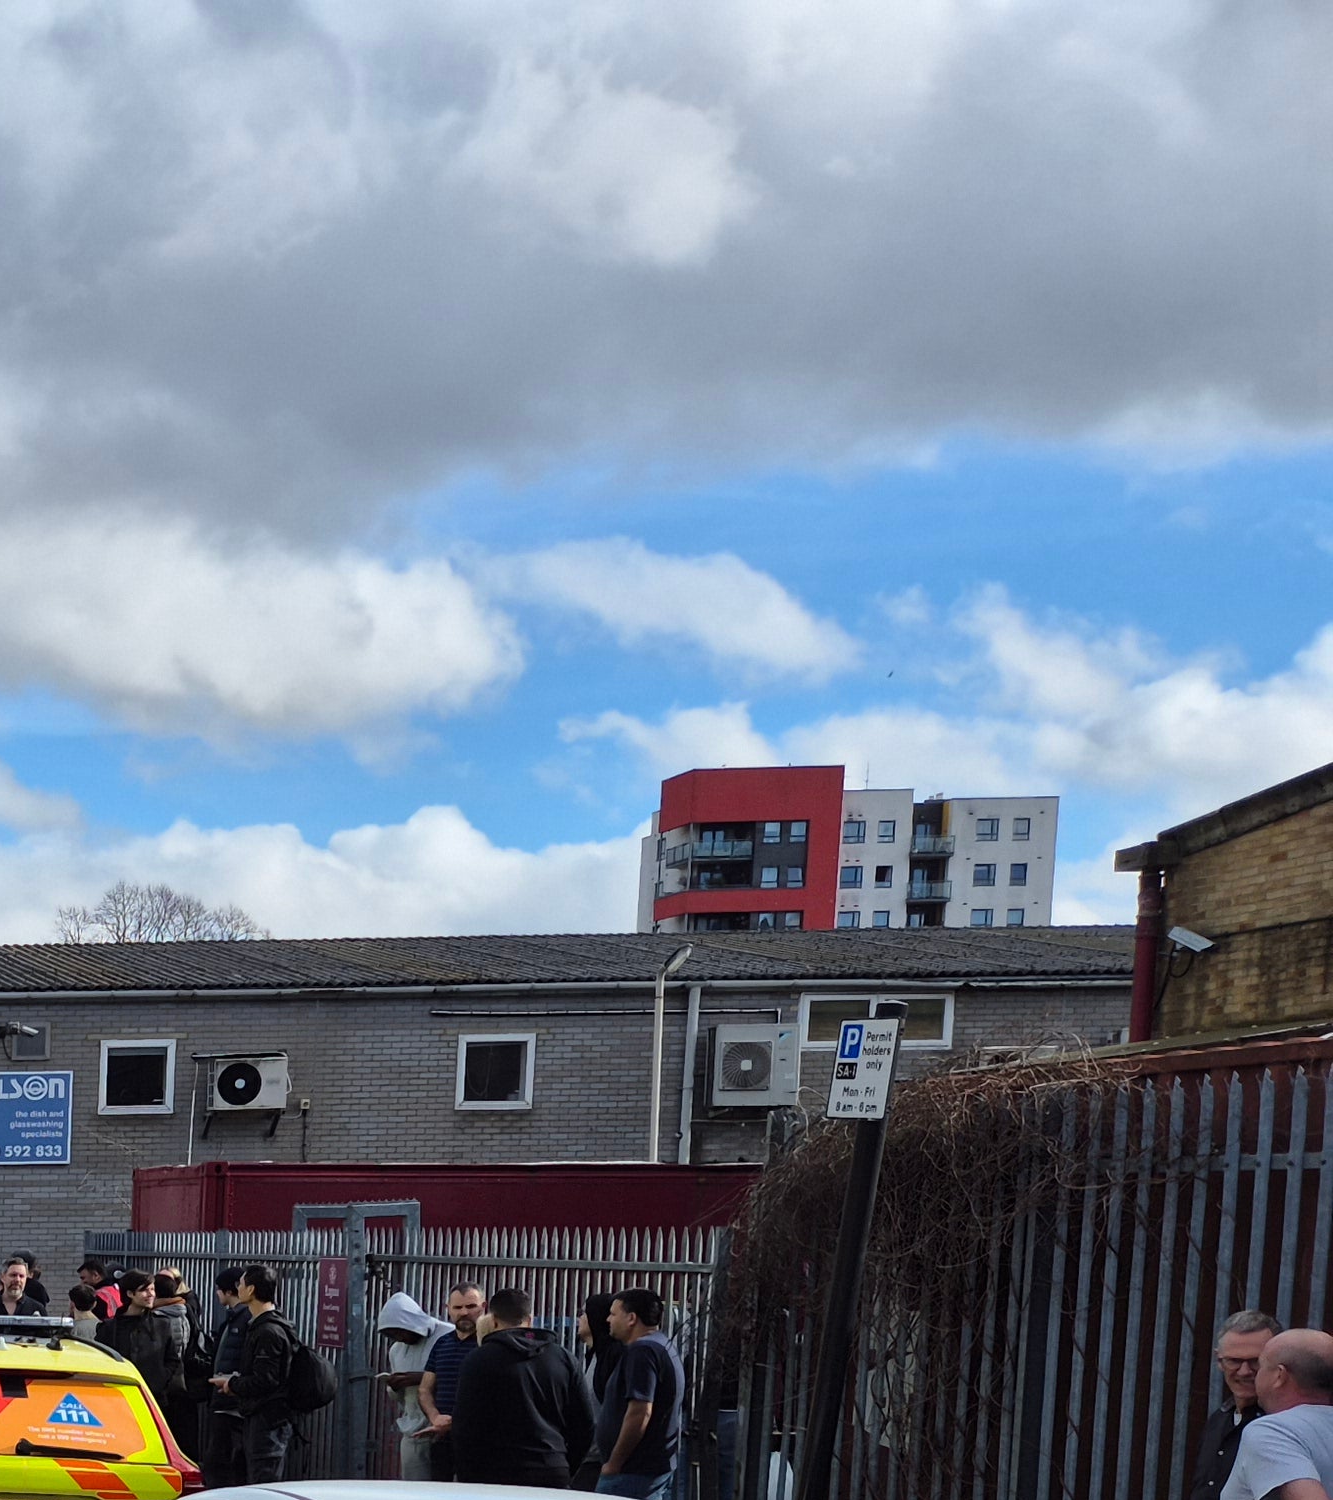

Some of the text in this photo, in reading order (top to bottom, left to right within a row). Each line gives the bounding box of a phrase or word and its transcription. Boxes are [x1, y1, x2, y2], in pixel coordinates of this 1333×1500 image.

[866, 1031, 893, 1042] Permit
[862, 1045, 891, 1056] holders
[865, 1059, 883, 1072] only
[842, 1086, 859, 1097] Mon
[864, 1086, 876, 1097] Fri
[15, 1110, 64, 1118] the dish and
[9, 1121, 64, 1130] glasswashing
[21, 1130, 63, 1139] specialists
[4, 1145, 31, 1158] 592
[35, 1145, 63, 1157] 833
[59, 1402, 85, 1410] CALL
[56, 1409, 90, 1424] 111
